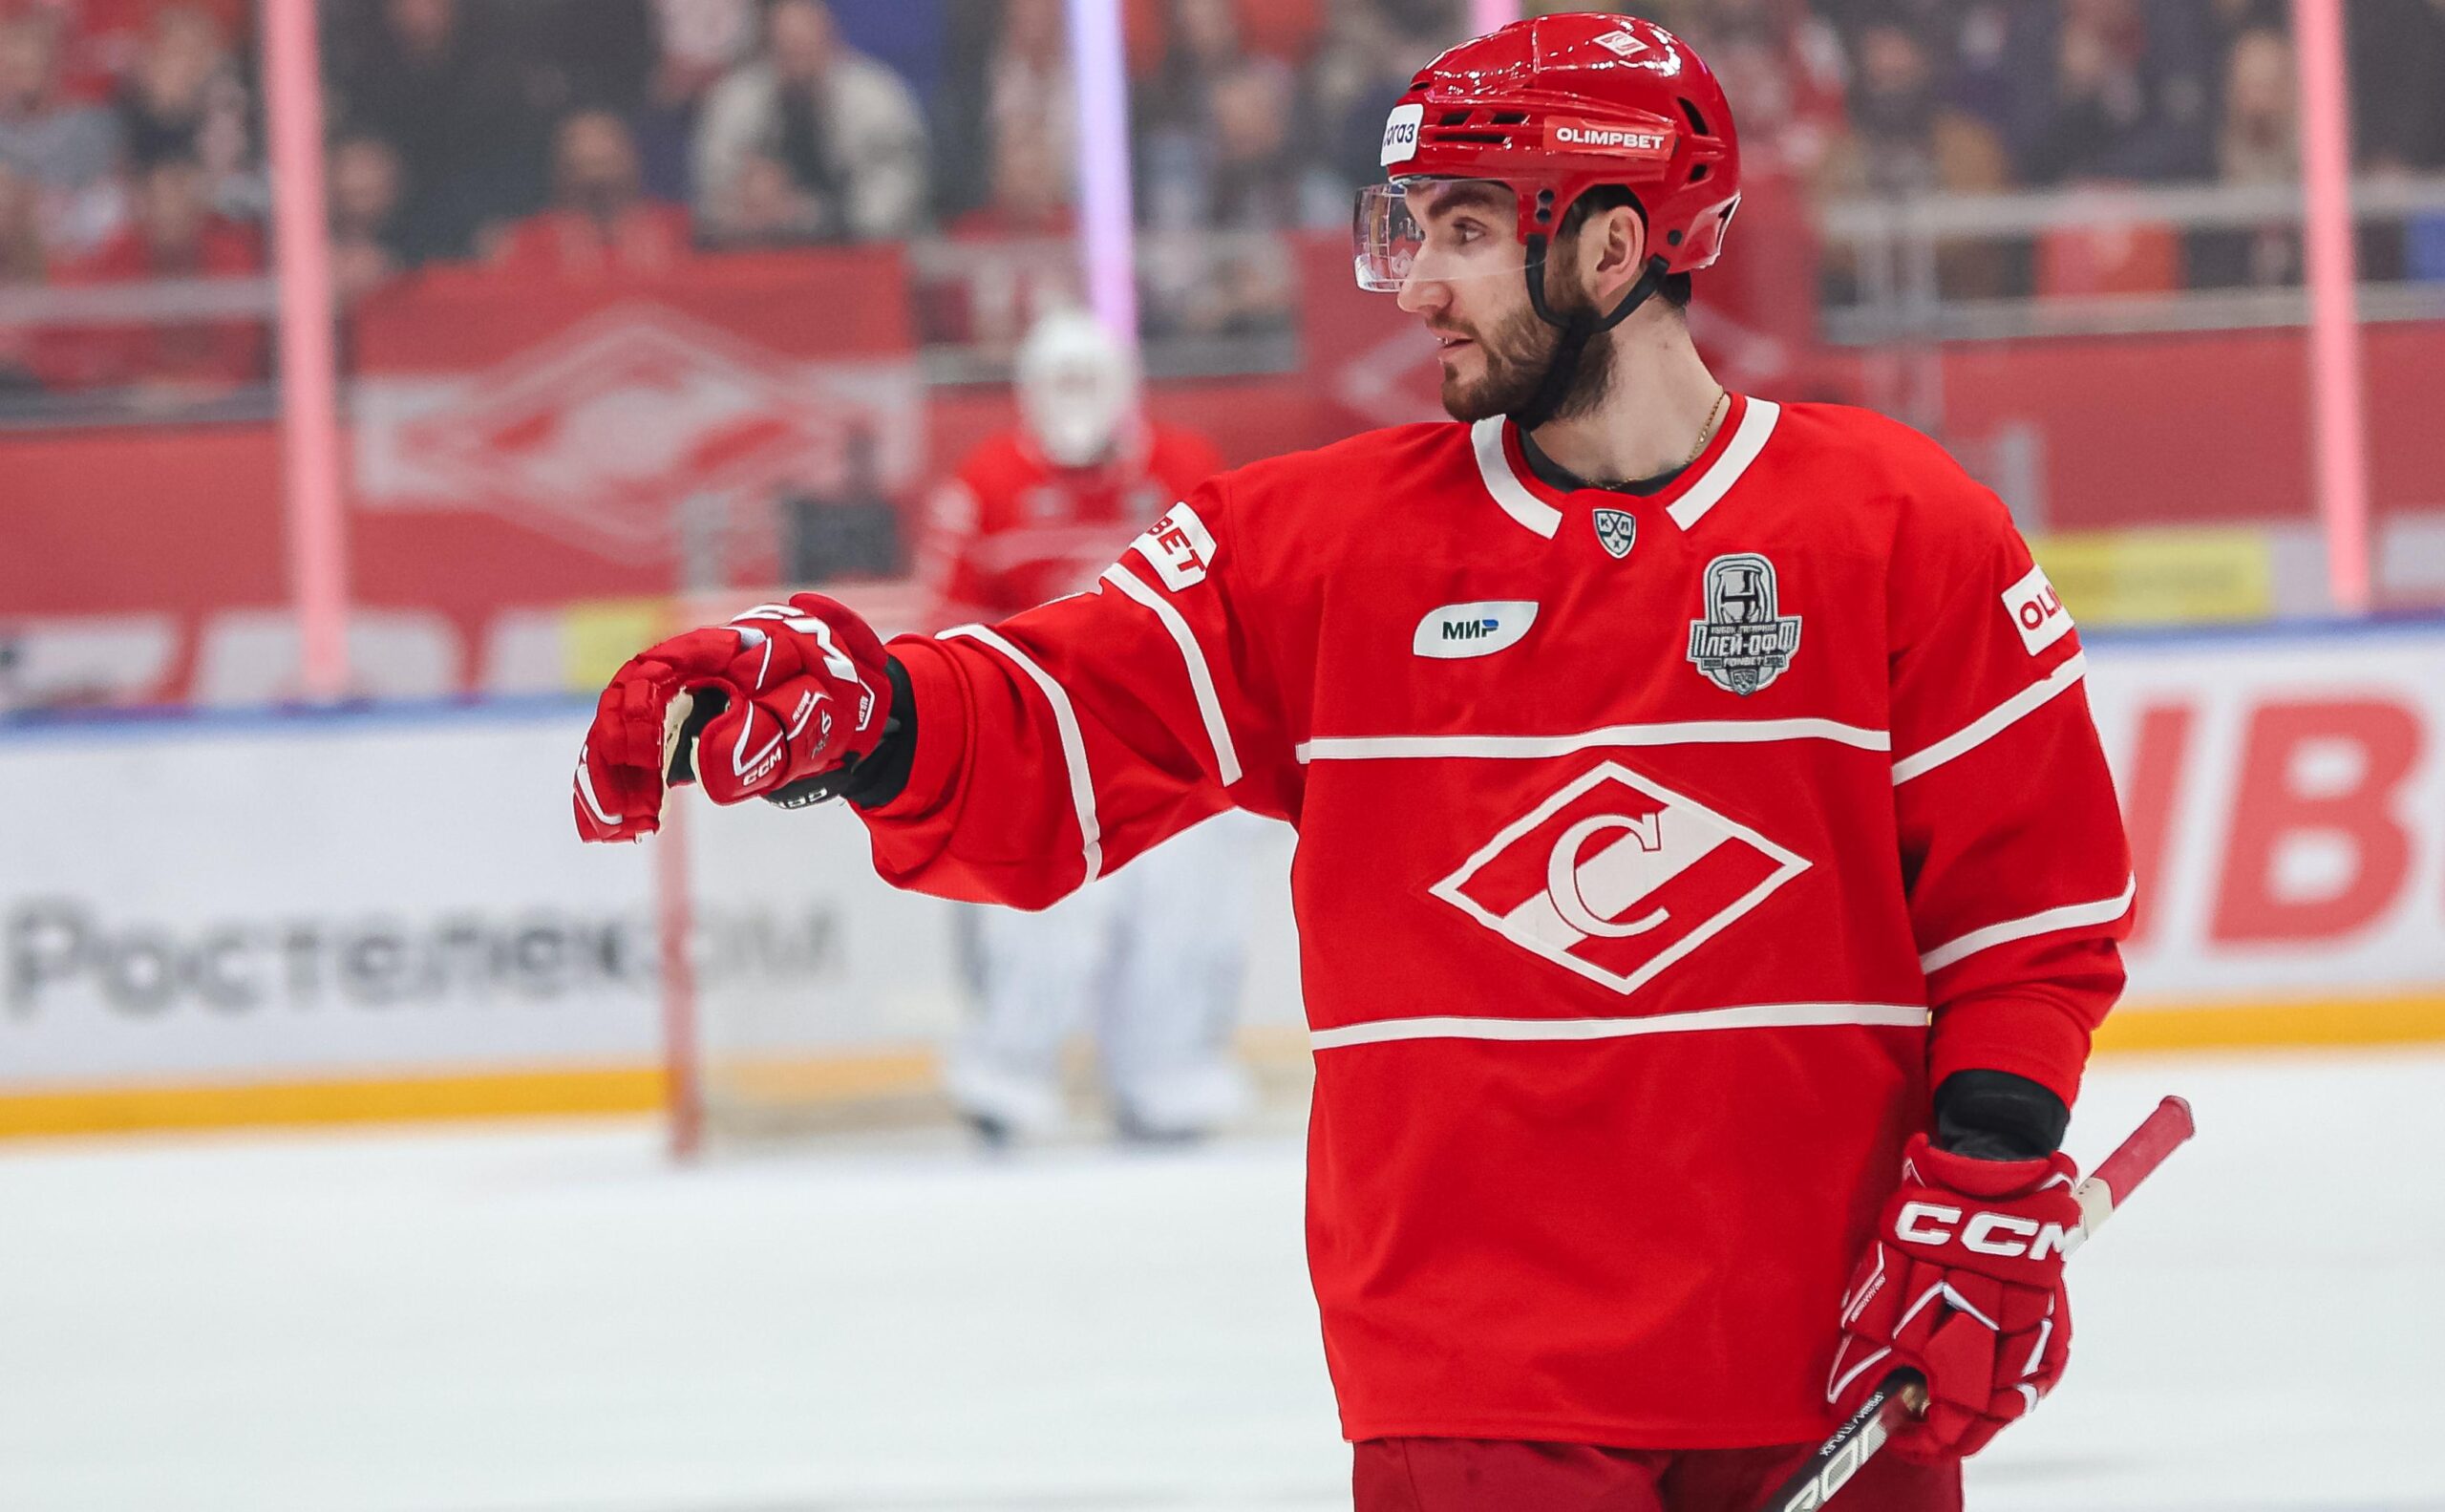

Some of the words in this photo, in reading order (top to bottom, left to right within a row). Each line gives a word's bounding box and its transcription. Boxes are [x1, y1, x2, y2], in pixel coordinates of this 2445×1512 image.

[1556, 127, 1665, 150] OLIMPBET
[1442, 618, 1499, 640] МИР
[1693, 622, 1796, 656] ПЛЕЙ-ОФФ
[742, 746, 782, 787] CCM
[1895, 1201, 2082, 1261] CCM
